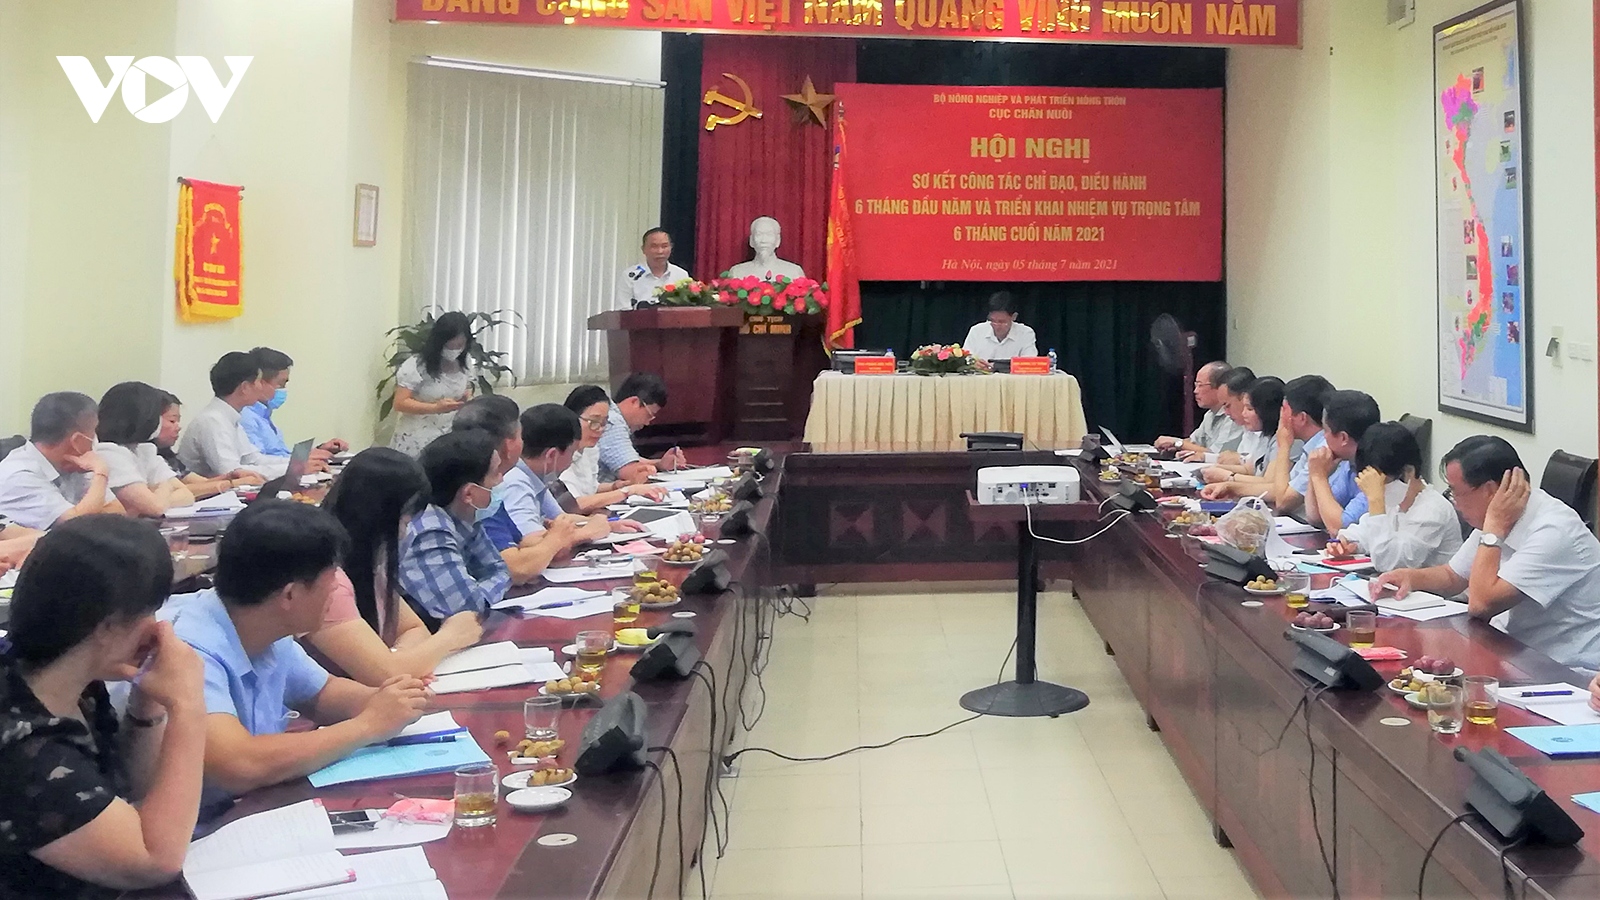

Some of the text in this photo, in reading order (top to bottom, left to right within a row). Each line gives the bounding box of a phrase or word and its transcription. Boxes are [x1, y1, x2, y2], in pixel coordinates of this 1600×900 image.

[804, 0, 883, 26] NAM
[895, 0, 1004, 30] QUANG
[1018, 0, 1091, 32] VINH
[1206, 0, 1276, 36] NĂM
[933, 92, 946, 105] BỘ
[948, 92, 974, 104] NÔNG
[975, 93, 1008, 105] NGHIỆP
[1010, 94, 1023, 104] VÀ
[1024, 94, 1047, 105] PHÁT
[988, 107, 1073, 121] CỤC CHĂN NUÔI
[970, 133, 1090, 163] HỘI NGHỊ
[912, 169, 1147, 194] SƠ KẾT CÔNG TÁC CHỈ ĐẠO, ĐIỀU HÀNH
[854, 194, 1201, 220] 6 THÁNG ĐẦU NĂM VÀ TRIỂN KHAI NHIỆM VỤ TRỌNG TÂM
[953, 220, 1105, 242] 6 THÁNG CUỐI NĂM 2021
[941, 259, 1118, 272] Hà Nội, ngày 05 tháng 7 năm 2021
